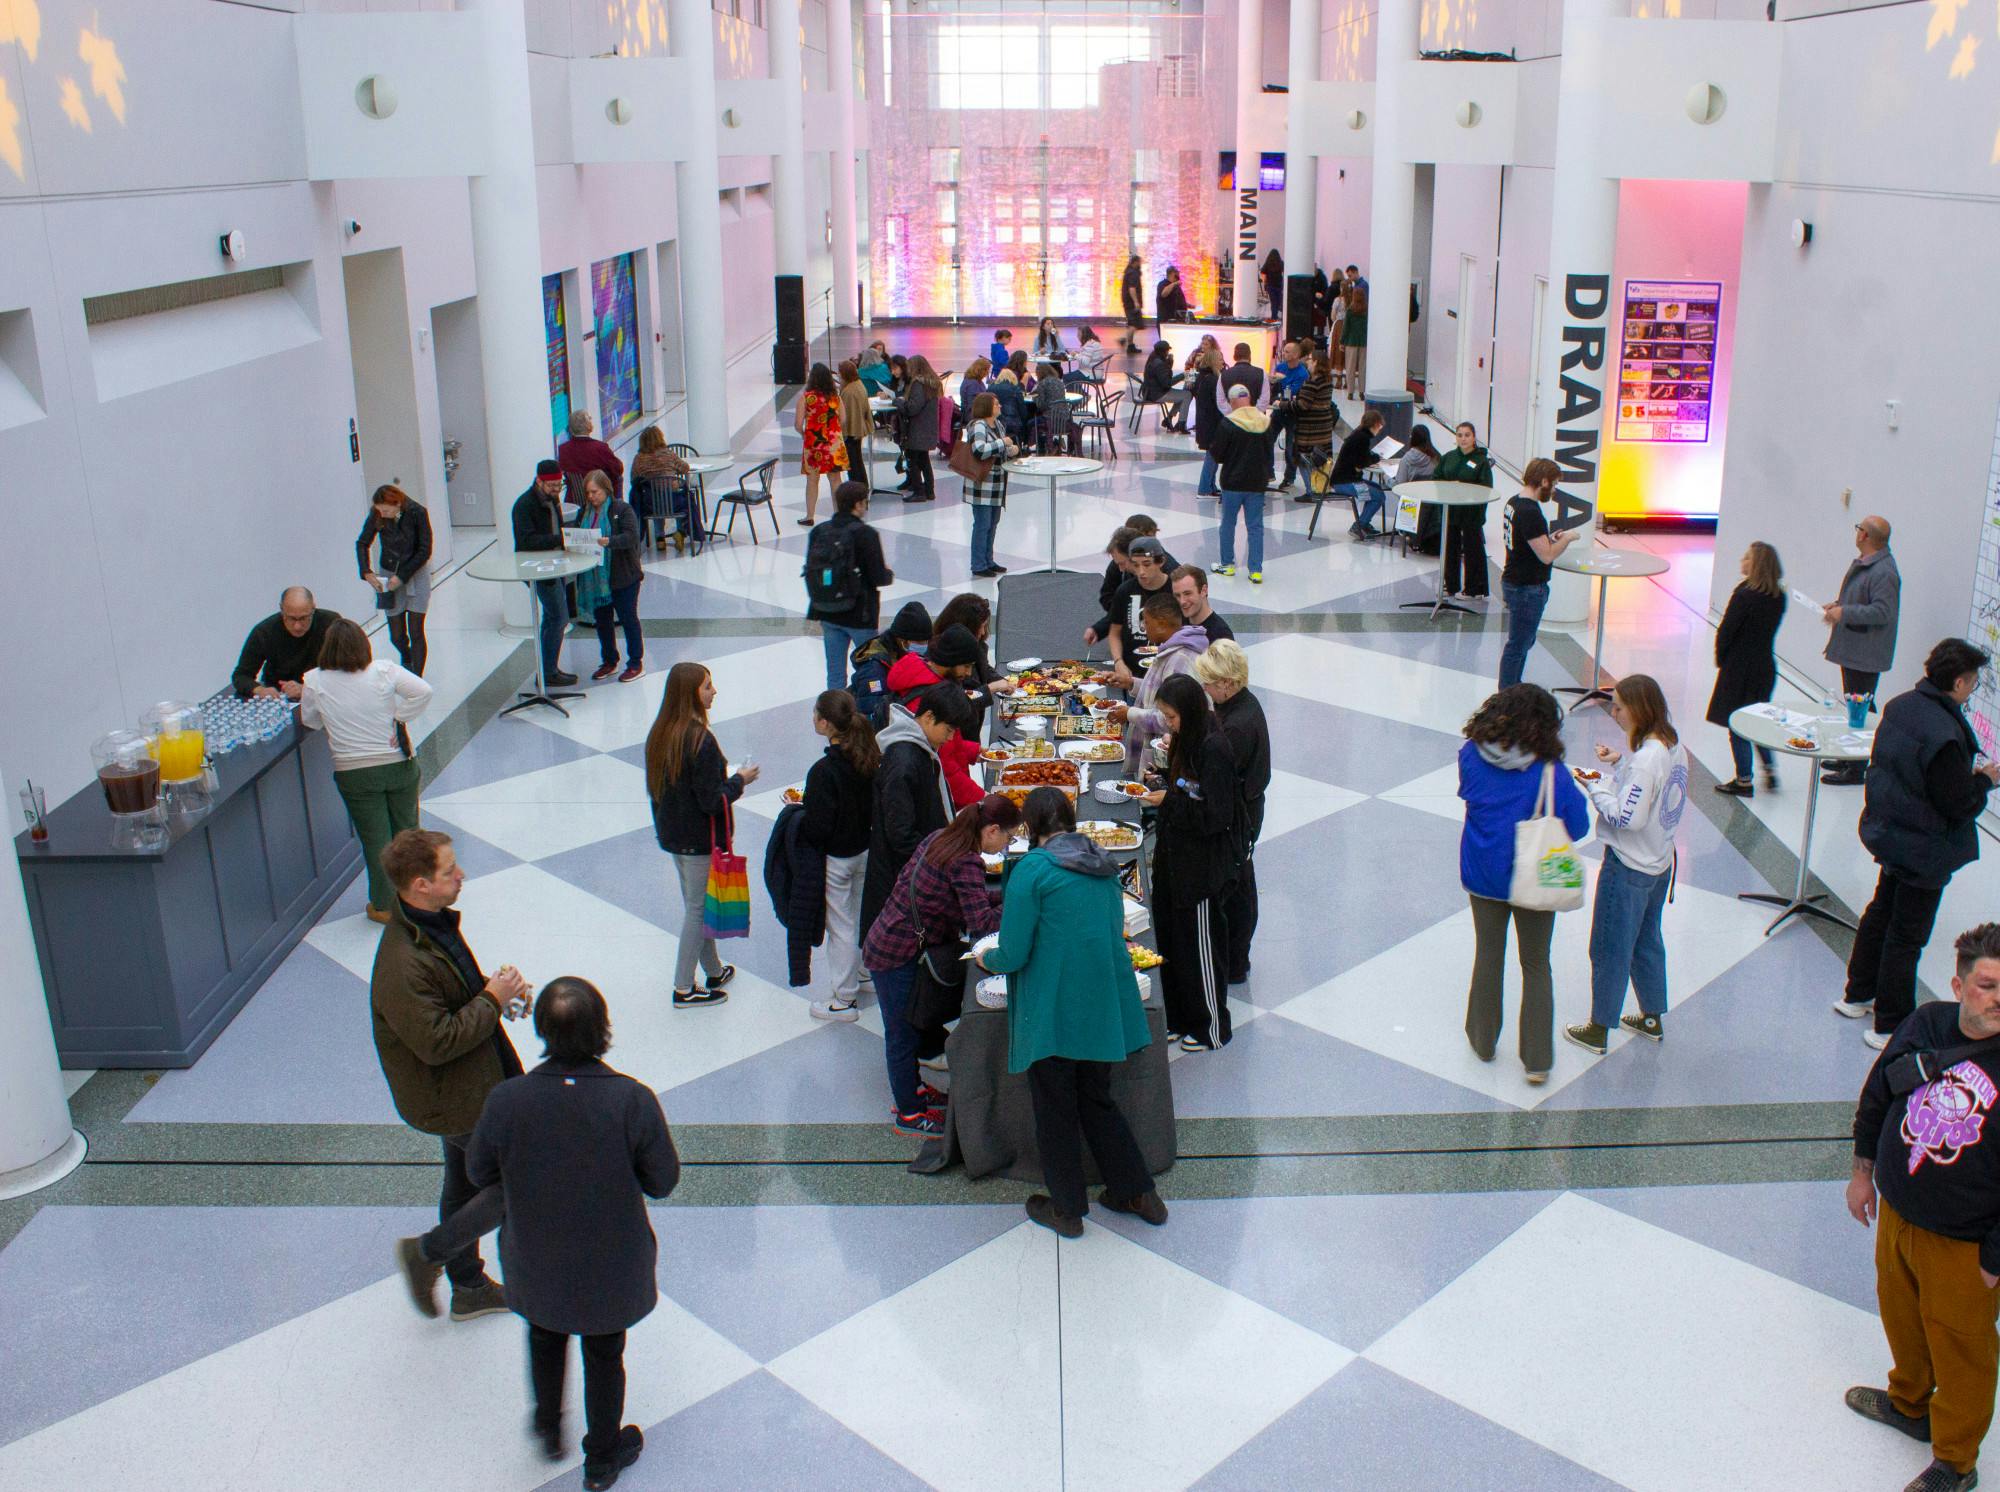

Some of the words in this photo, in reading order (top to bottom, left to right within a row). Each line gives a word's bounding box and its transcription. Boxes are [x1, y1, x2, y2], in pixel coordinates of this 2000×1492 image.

[1239, 188, 1257, 260] MAIN
[1549, 274, 1609, 533] DRAMA
[1625, 784, 1643, 806] ALL
